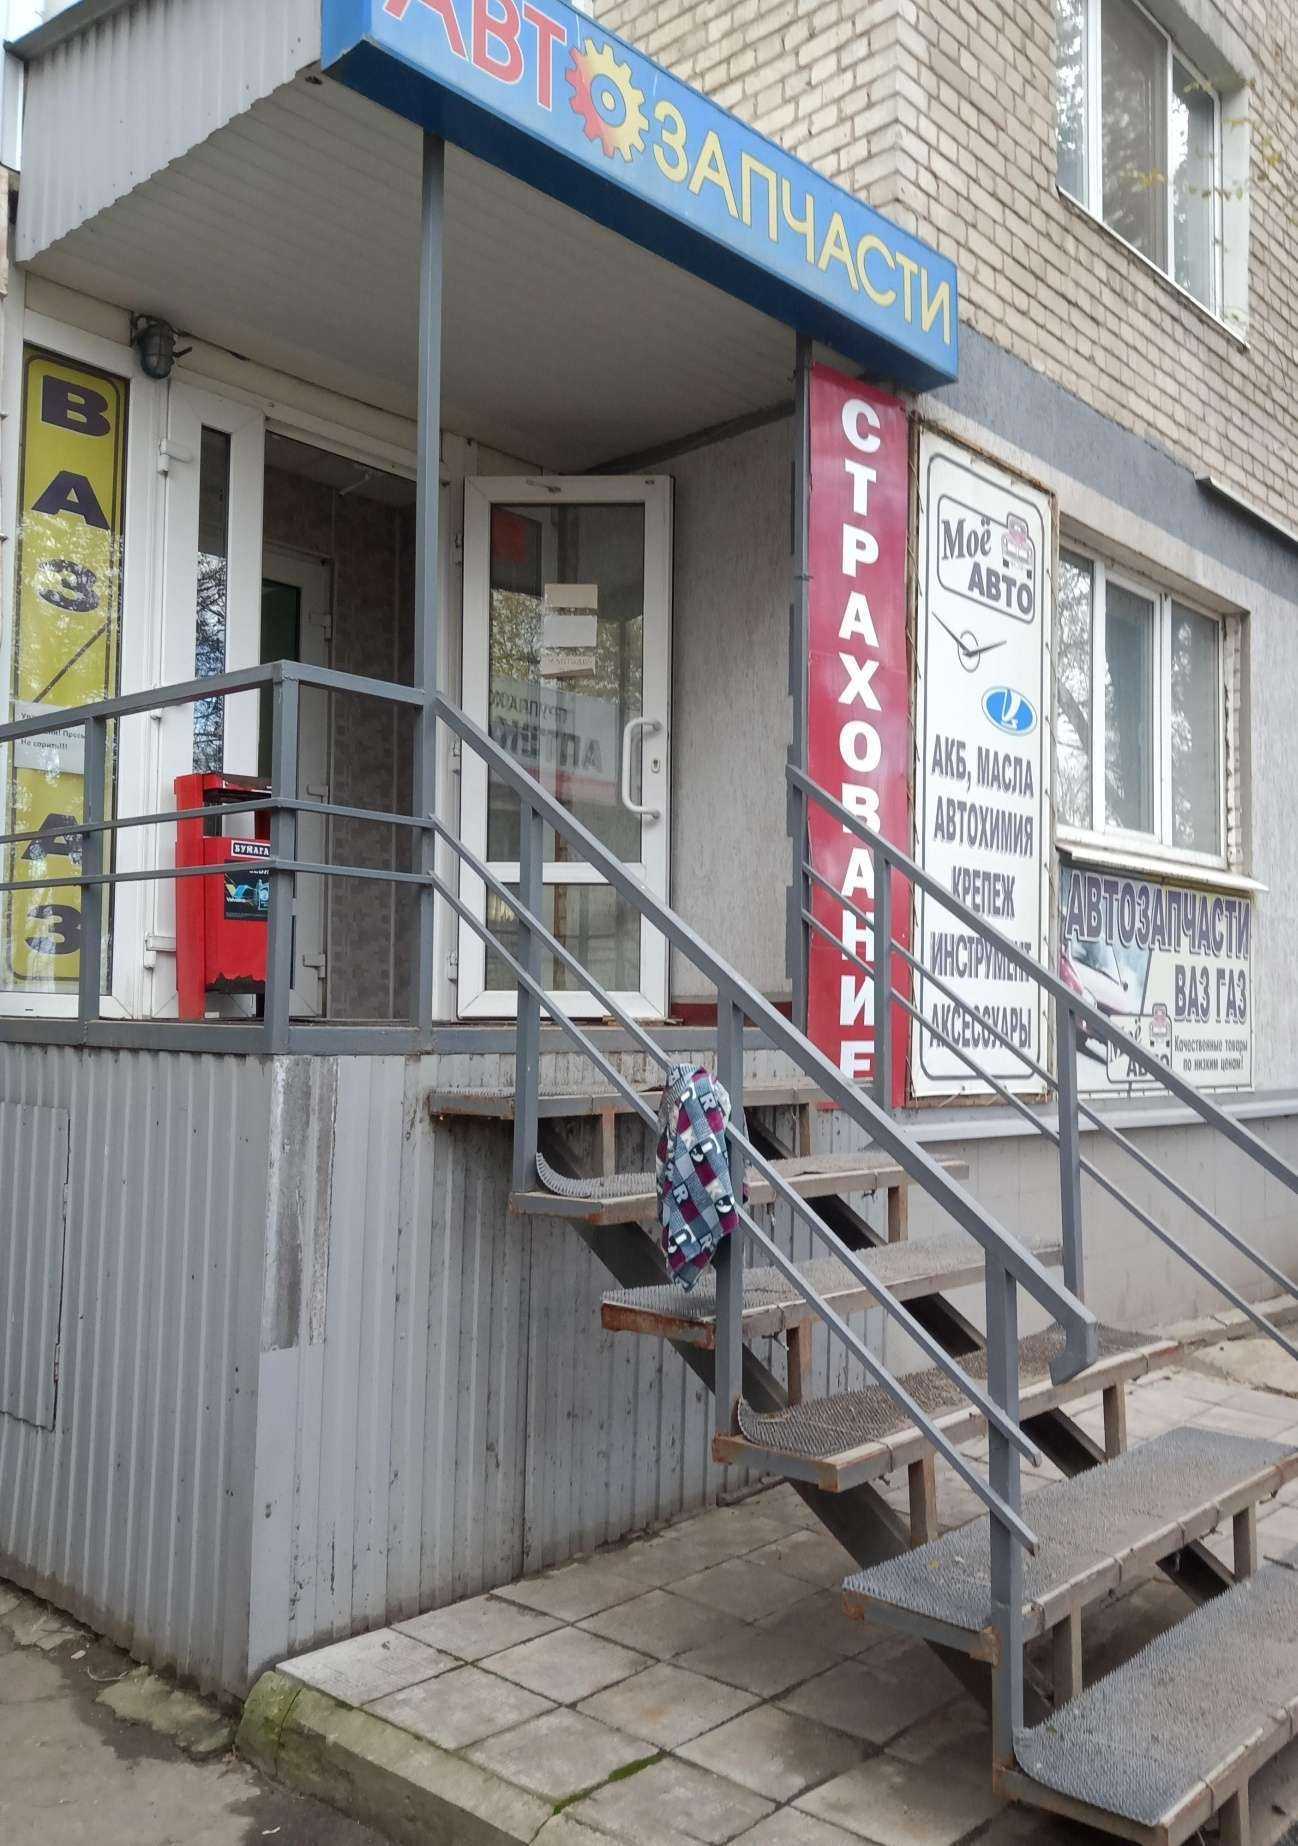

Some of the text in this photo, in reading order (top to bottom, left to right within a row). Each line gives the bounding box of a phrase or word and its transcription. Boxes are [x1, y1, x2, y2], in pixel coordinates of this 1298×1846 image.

[941, 517, 992, 560] Моё
[967, 561, 1034, 615] АВТО
[838, 398, 883, 1081] СТРАХОВАНИЕ
[930, 733, 1034, 798] АКБ, МАСЛА
[932, 795, 1034, 858] АВТОХИМИЯ
[951, 865, 1016, 921] КРЕПЕЖ
[1065, 870, 1250, 961] АВТОЗАПЧАСТИ
[1174, 963, 1248, 1024] ВАЗ ГАЗ
